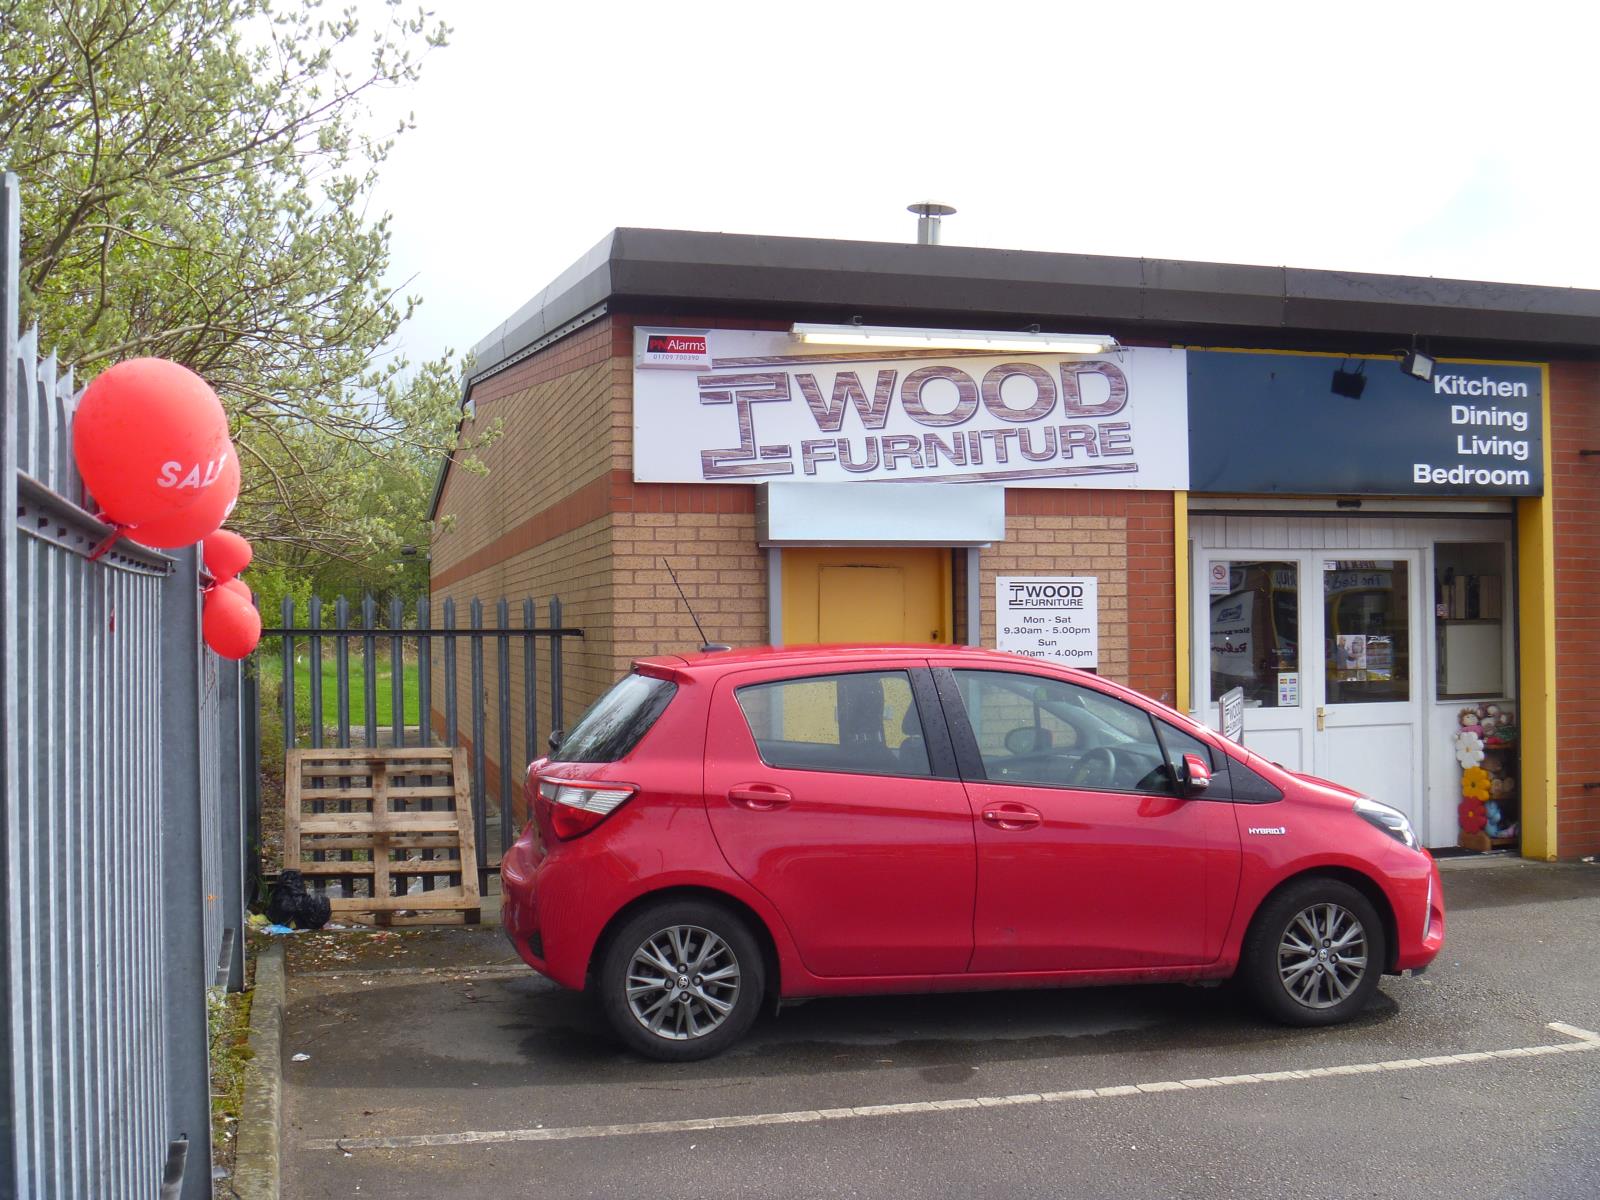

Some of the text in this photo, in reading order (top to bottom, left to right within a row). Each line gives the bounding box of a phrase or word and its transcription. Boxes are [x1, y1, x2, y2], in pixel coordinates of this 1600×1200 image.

[1433, 375, 1528, 398] Kitchen
[795, 360, 1128, 432] WOOD
[1451, 405, 1528, 432] Dining
[801, 421, 1134, 475] FURNITURE
[1457, 435, 1529, 461] Living
[1413, 463, 1530, 485] Bedroom
[1025, 585, 1084, 598] WOOD
[1025, 599, 1084, 607] FURNITURE
[1023, 616, 1045, 624] Mon
[1055, 615, 1072, 624] Sat
[1003, 626, 1043, 635] 9.30am
[1052, 626, 1091, 636] 5.00pm
[1038, 638, 1057, 647] Sun
[1054, 649, 1093, 658] 4.00pm
